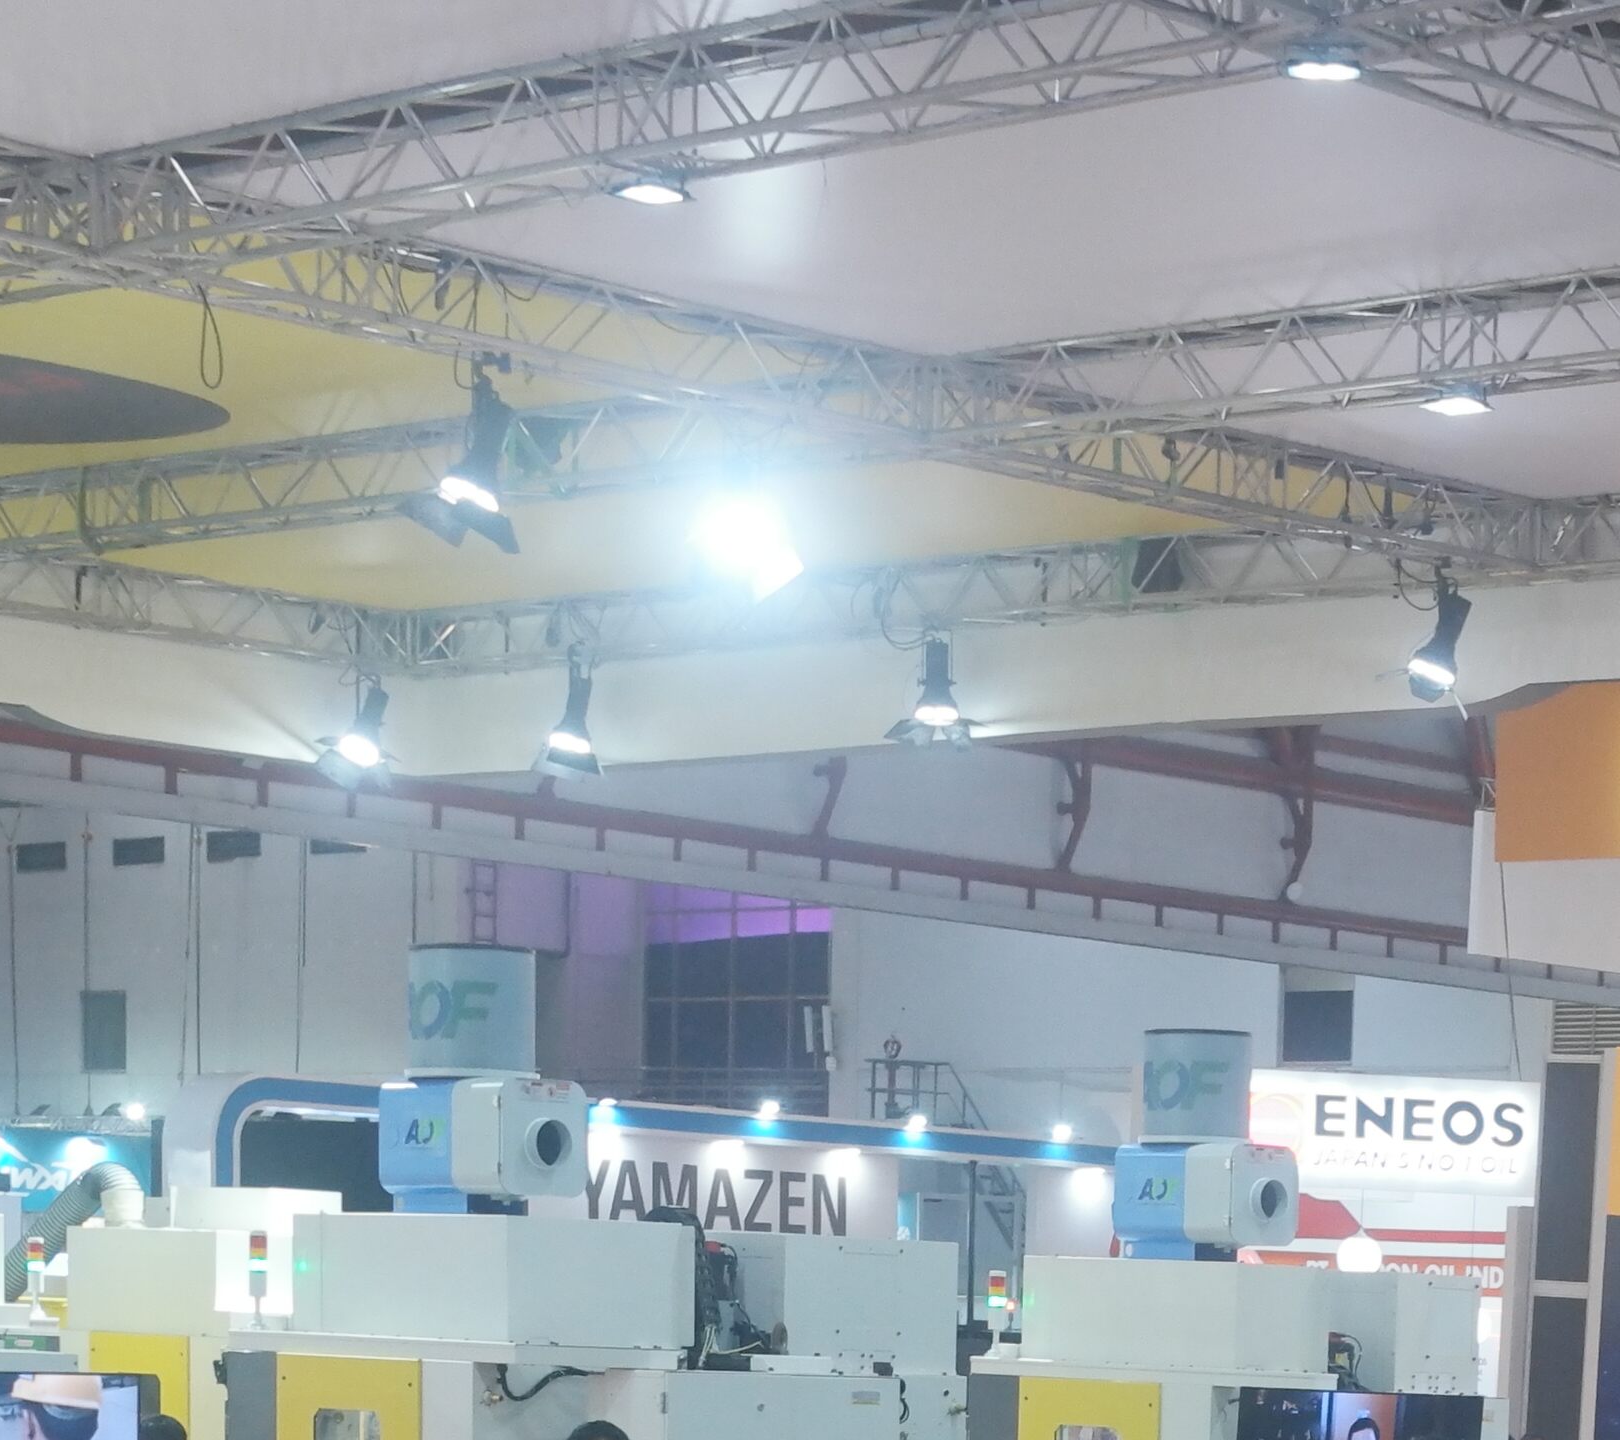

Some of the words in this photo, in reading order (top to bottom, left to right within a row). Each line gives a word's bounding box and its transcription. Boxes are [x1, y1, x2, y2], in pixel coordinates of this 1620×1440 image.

[408, 979, 500, 1041] OF
[1313, 1093, 1525, 1148] ENEOS
[1481, 1156, 1518, 1176] OIL
[583, 1158, 848, 1237] YAMAZEN
